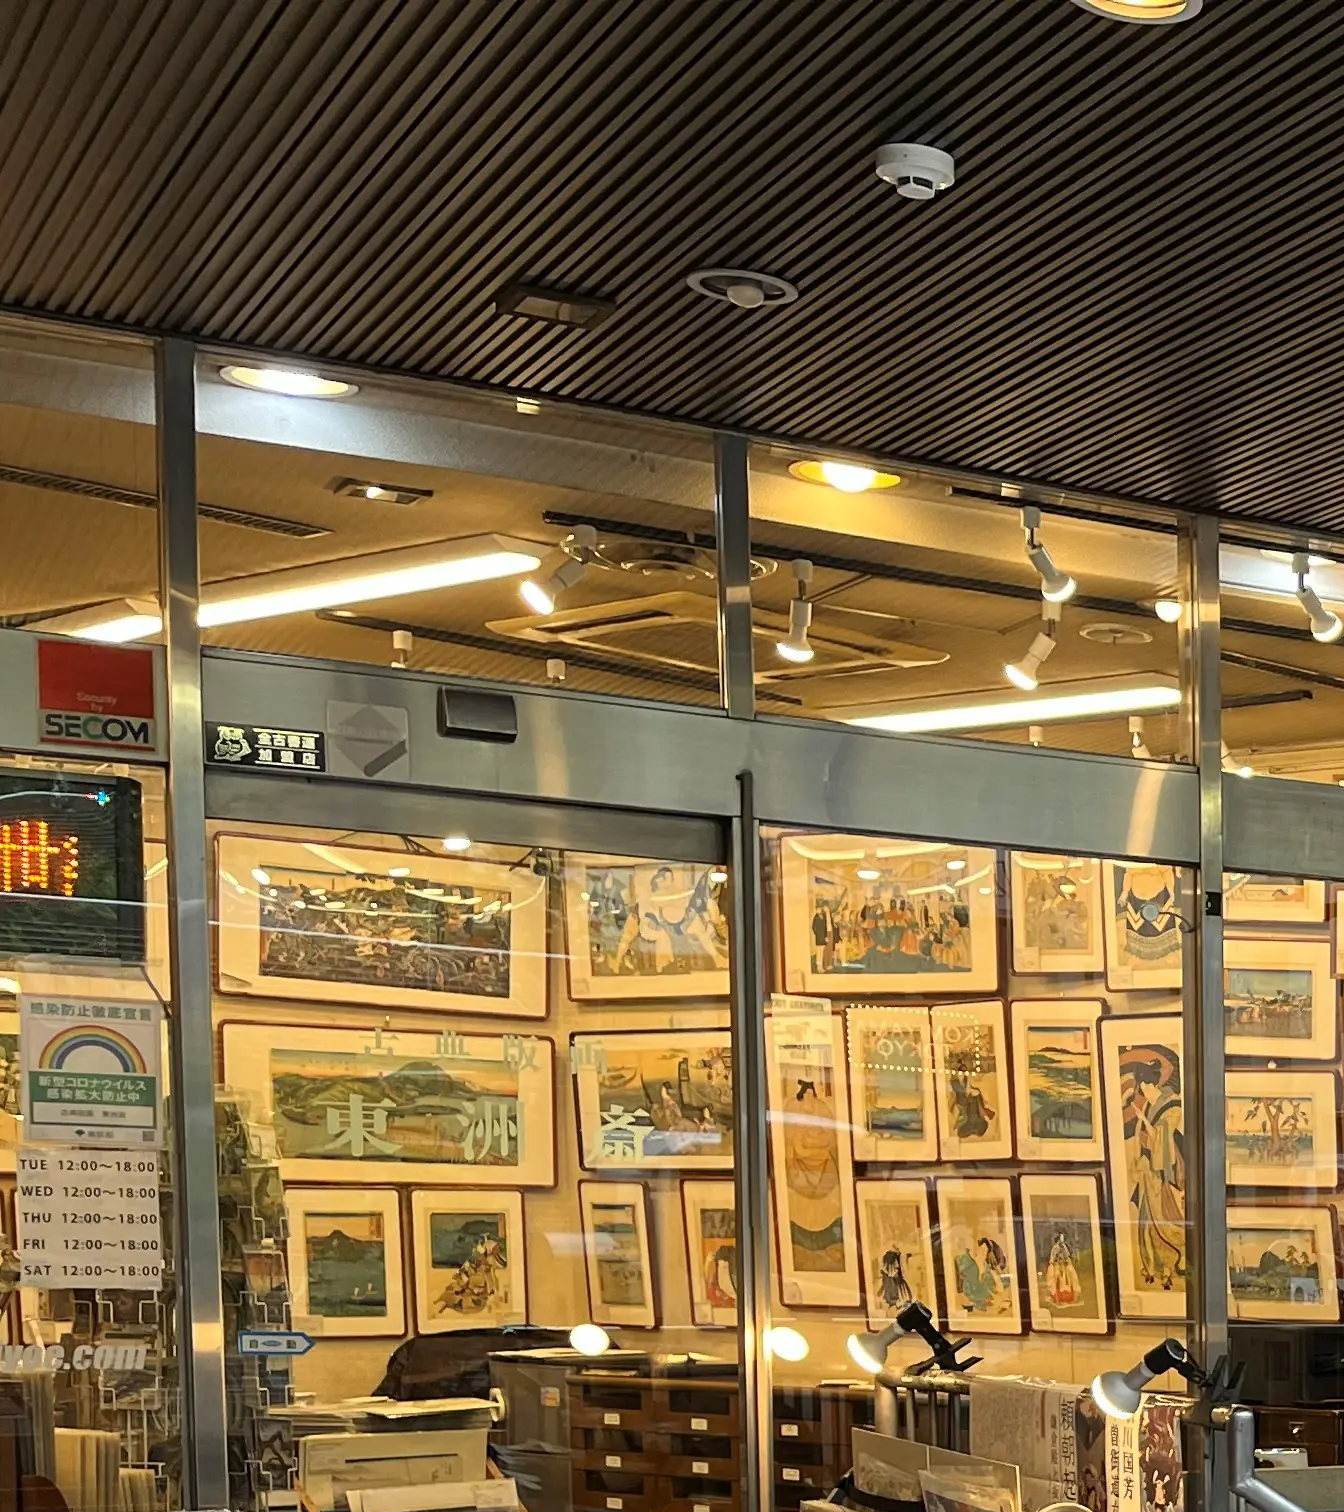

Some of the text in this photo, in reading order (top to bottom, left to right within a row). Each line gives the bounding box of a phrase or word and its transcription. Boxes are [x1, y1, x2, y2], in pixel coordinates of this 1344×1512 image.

[77, 691, 117, 706] Security
[45, 713, 149, 744] SECOM
[30, 1002, 152, 1022] 感染防止徹底宣言
[38, 1075, 147, 1091] 新型コロナウイルス
[47, 1088, 140, 1103] 感染拡大防止中
[20, 1158, 47, 1171] TUE
[20, 1185, 53, 1197] WED
[22, 1212, 52, 1224] THU
[22, 1238, 45, 1250] FRI
[24, 1264, 52, 1276] SAT
[1123, 1418, 1135, 1500] 川国芳
